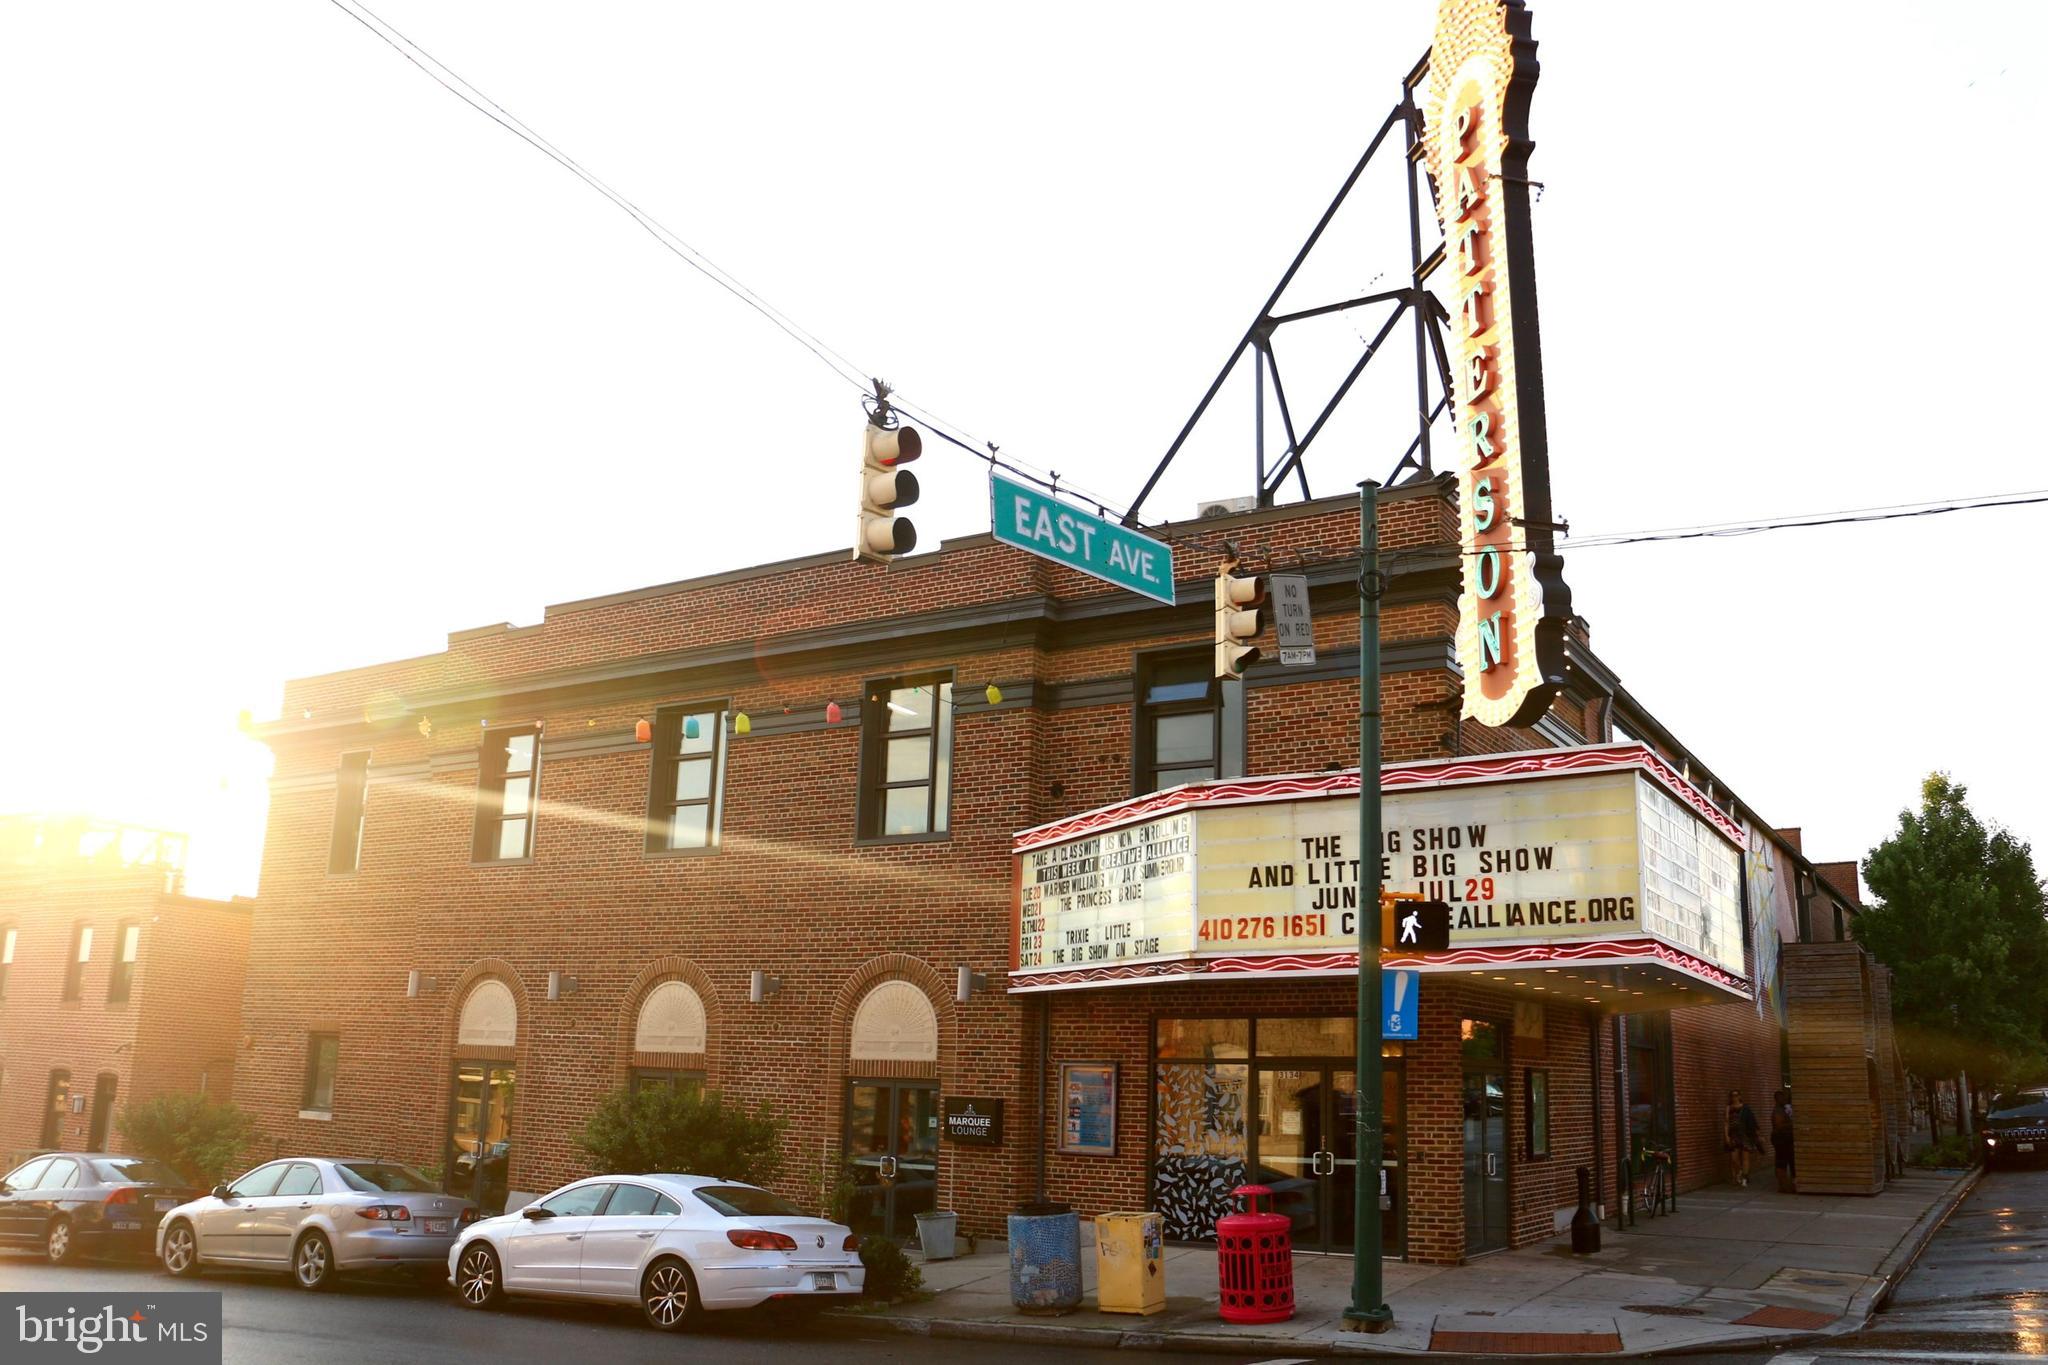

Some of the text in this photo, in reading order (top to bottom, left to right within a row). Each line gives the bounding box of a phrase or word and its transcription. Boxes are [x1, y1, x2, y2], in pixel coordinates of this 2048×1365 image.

[1015, 495, 1160, 584] EAST AVE.
[1284, 584, 1297, 598] NO
[1282, 604, 1304, 617] TURN
[1279, 623, 1310, 637] ON RED
[1282, 651, 1312, 662] 7AM-7PM
[1300, 825, 1487, 860] THE IG SHOW
[1032, 851, 1048, 868] TAKE
[1052, 849, 1057, 863] A
[1042, 837, 1190, 881] THIS WEEK AT CREATIVE ALLIANCE
[1248, 847, 1554, 889] AND LITTE BIG SHOW
[1122, 866, 1137, 883] JAY
[1060, 896, 1072, 912] THE
[1076, 889, 1112, 908] PRINCESS
[1066, 928, 1089, 946] TRIXIE
[1105, 922, 1131, 941] LITTLE
[1198, 918, 1232, 941] 410
[1237, 916, 1275, 940] 276
[1283, 914, 1325, 937] 1651
[1052, 949, 1065, 964] THE
[1071, 947, 1083, 962] BIG
[1088, 944, 1109, 960] SHOW
[1115, 942, 1126, 957] ON
[1134, 938, 1160, 955] STAGE
[949, 1117, 991, 1127] MARQUEE
[951, 1126, 987, 1136] LOUNGE
